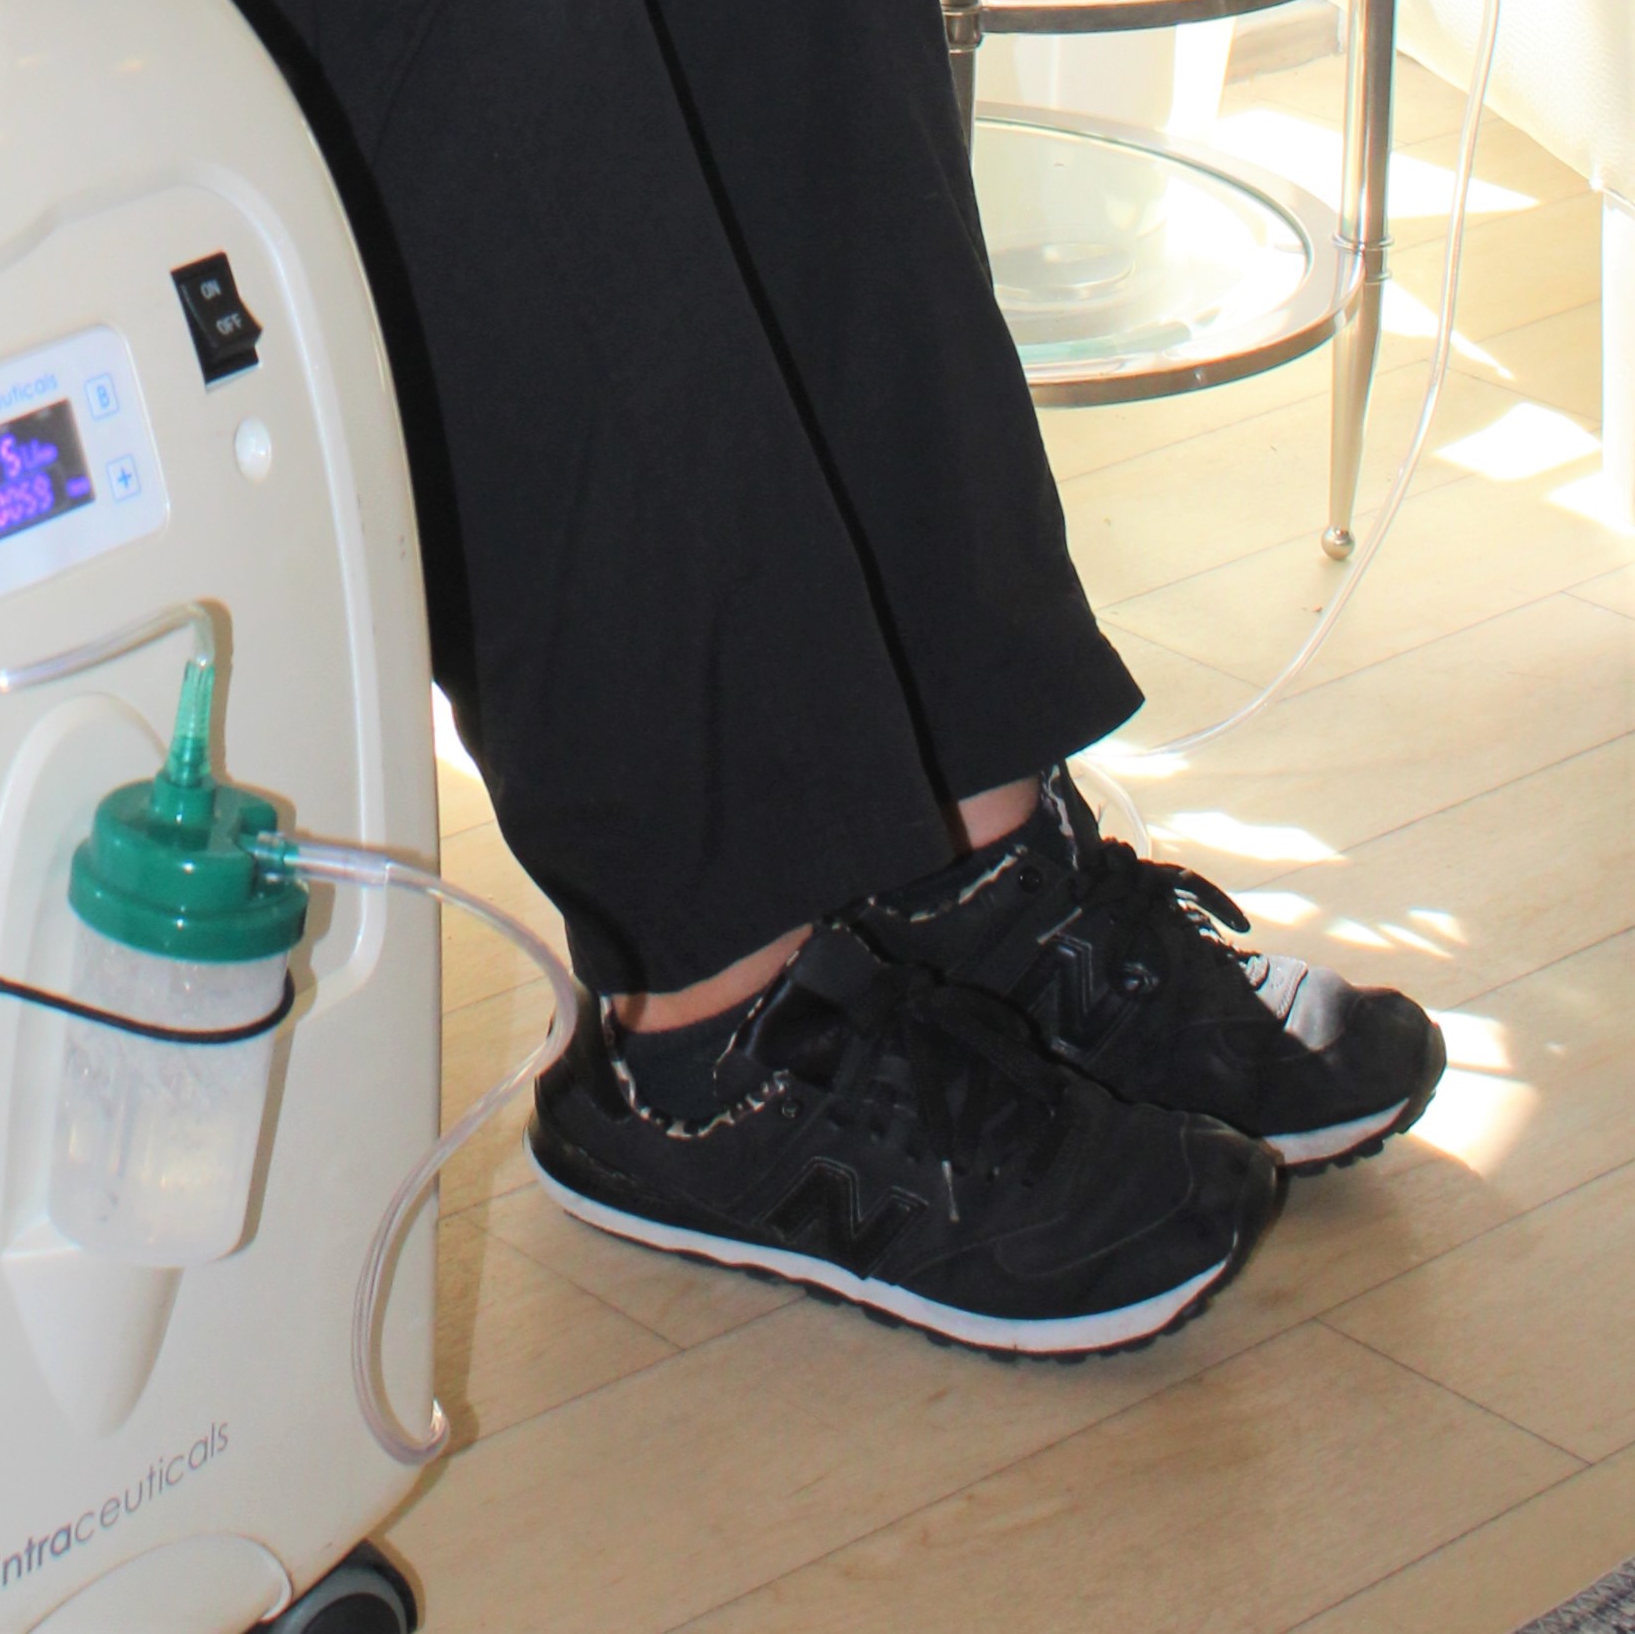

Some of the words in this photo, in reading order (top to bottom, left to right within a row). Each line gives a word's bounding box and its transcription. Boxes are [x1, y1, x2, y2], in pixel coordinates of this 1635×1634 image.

[200, 278, 222, 301] ON
[215, 311, 243, 336] OFF
[751, 1155, 929, 1279] N
